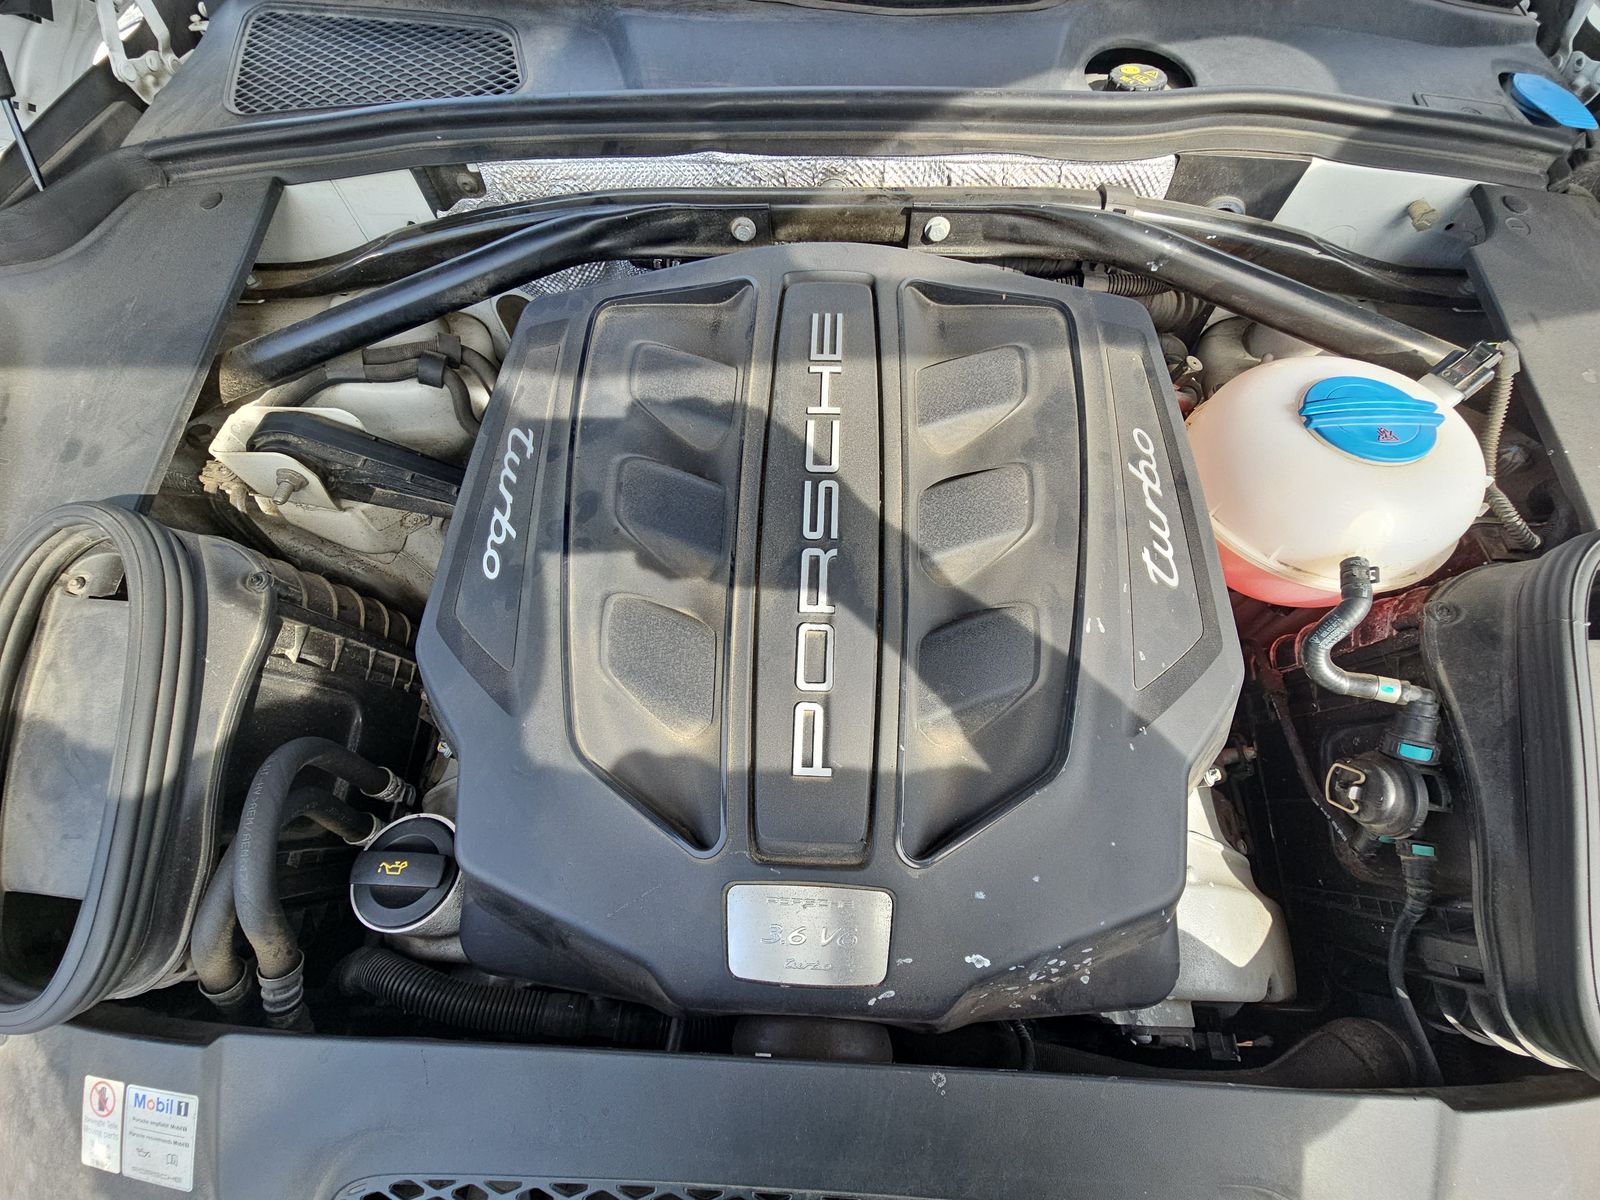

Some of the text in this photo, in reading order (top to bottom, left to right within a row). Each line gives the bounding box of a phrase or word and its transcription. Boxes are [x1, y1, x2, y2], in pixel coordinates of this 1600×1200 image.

[482, 427, 535, 580] turbo
[793, 312, 844, 777] PORSCHE
[1127, 427, 1180, 589] turbo
[133, 1093, 189, 1117] Mobil 1
